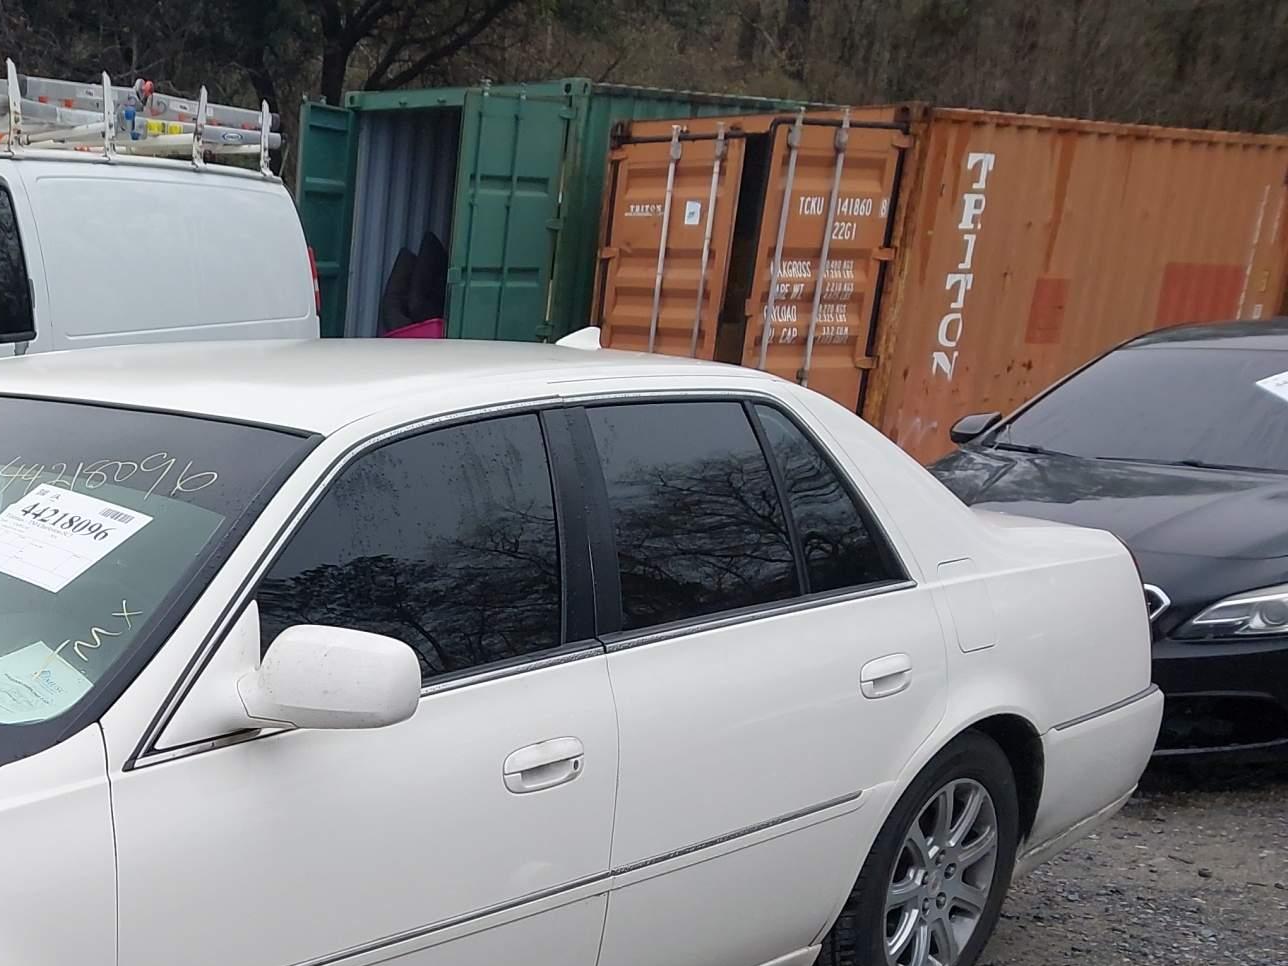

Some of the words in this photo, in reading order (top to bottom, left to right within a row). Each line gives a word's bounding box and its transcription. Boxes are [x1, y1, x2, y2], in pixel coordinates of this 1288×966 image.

[799, 196, 825, 216] TCKU
[837, 197, 873, 217] 141860
[832, 222, 857, 241] 22G1
[21, 502, 117, 542] 44218096
